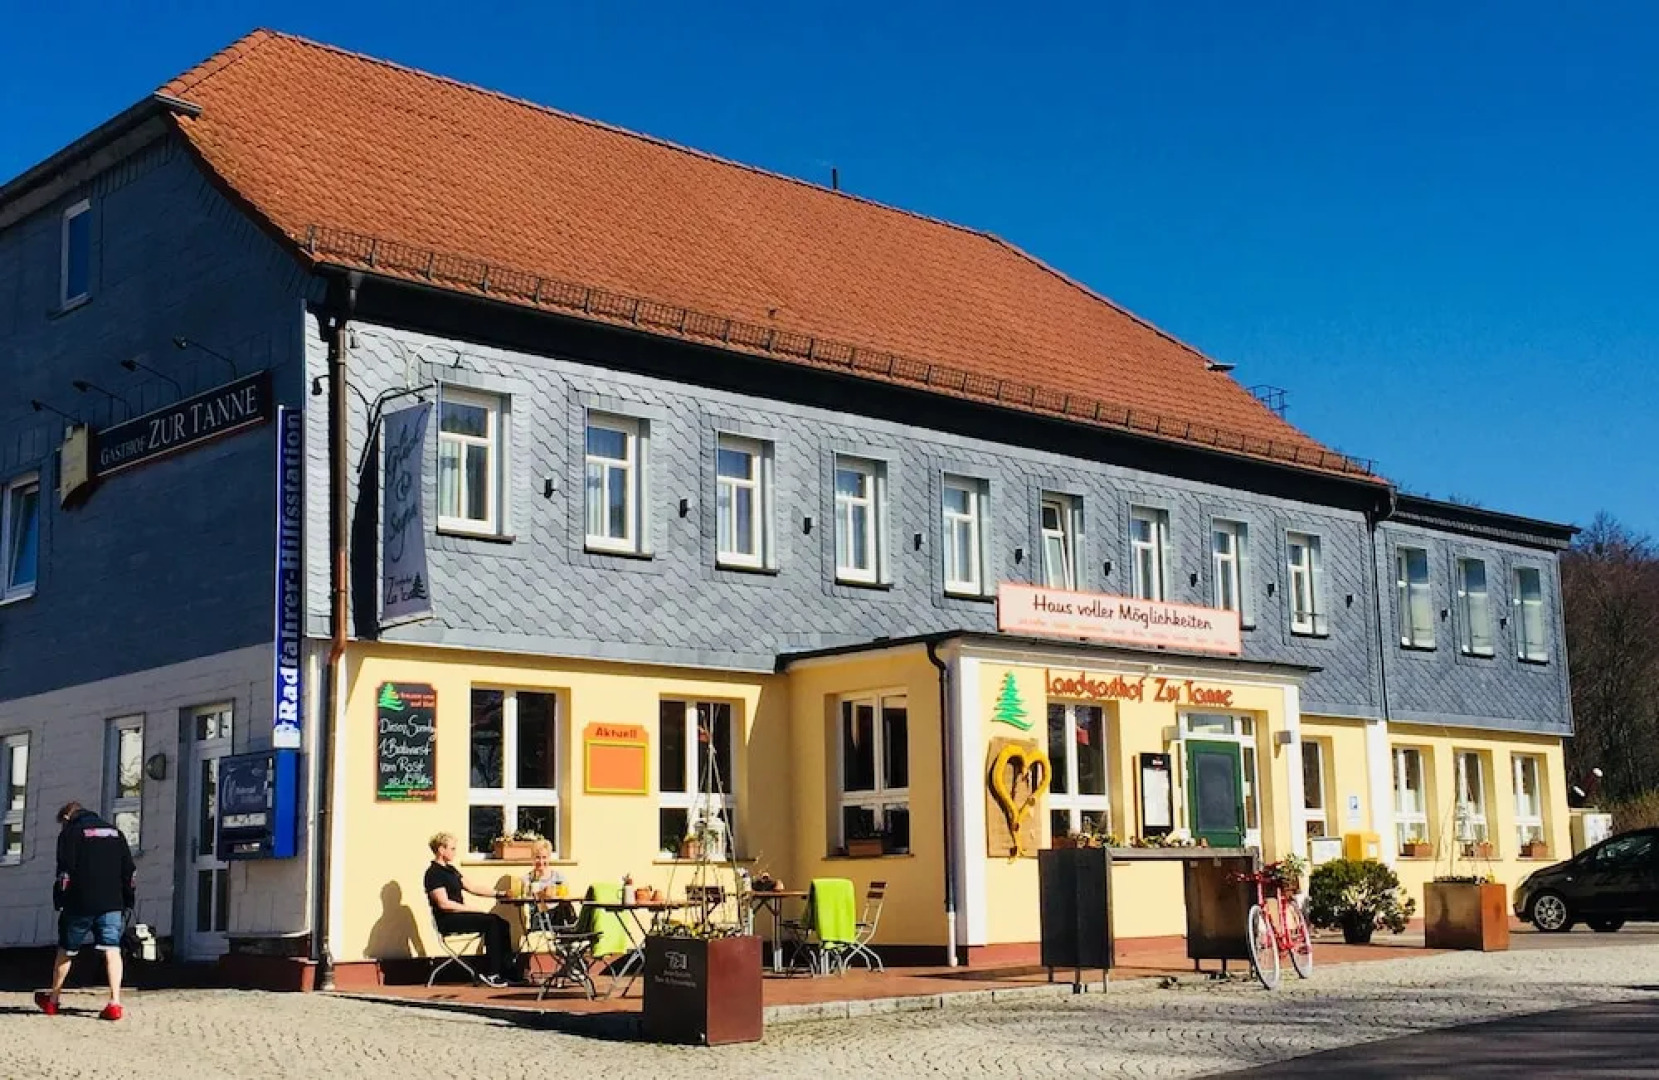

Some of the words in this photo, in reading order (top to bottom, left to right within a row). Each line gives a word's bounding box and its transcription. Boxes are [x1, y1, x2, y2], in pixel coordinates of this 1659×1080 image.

[100, 434, 146, 466] GASTHOF
[148, 412, 186, 449] ZUR
[190, 384, 259, 435] TANNE
[278, 413, 299, 723] Radfahrer-Hilfsstation
[1033, 593, 1073, 615] Haus
[1076, 598, 1115, 620] voller
[1118, 603, 1214, 631] Möglichkeiten
[1045, 667, 1146, 701] Landgasthof
[1153, 676, 1182, 703] Zur
[1183, 679, 1234, 706] Tanne
[595, 727, 638, 739] Aktuell
